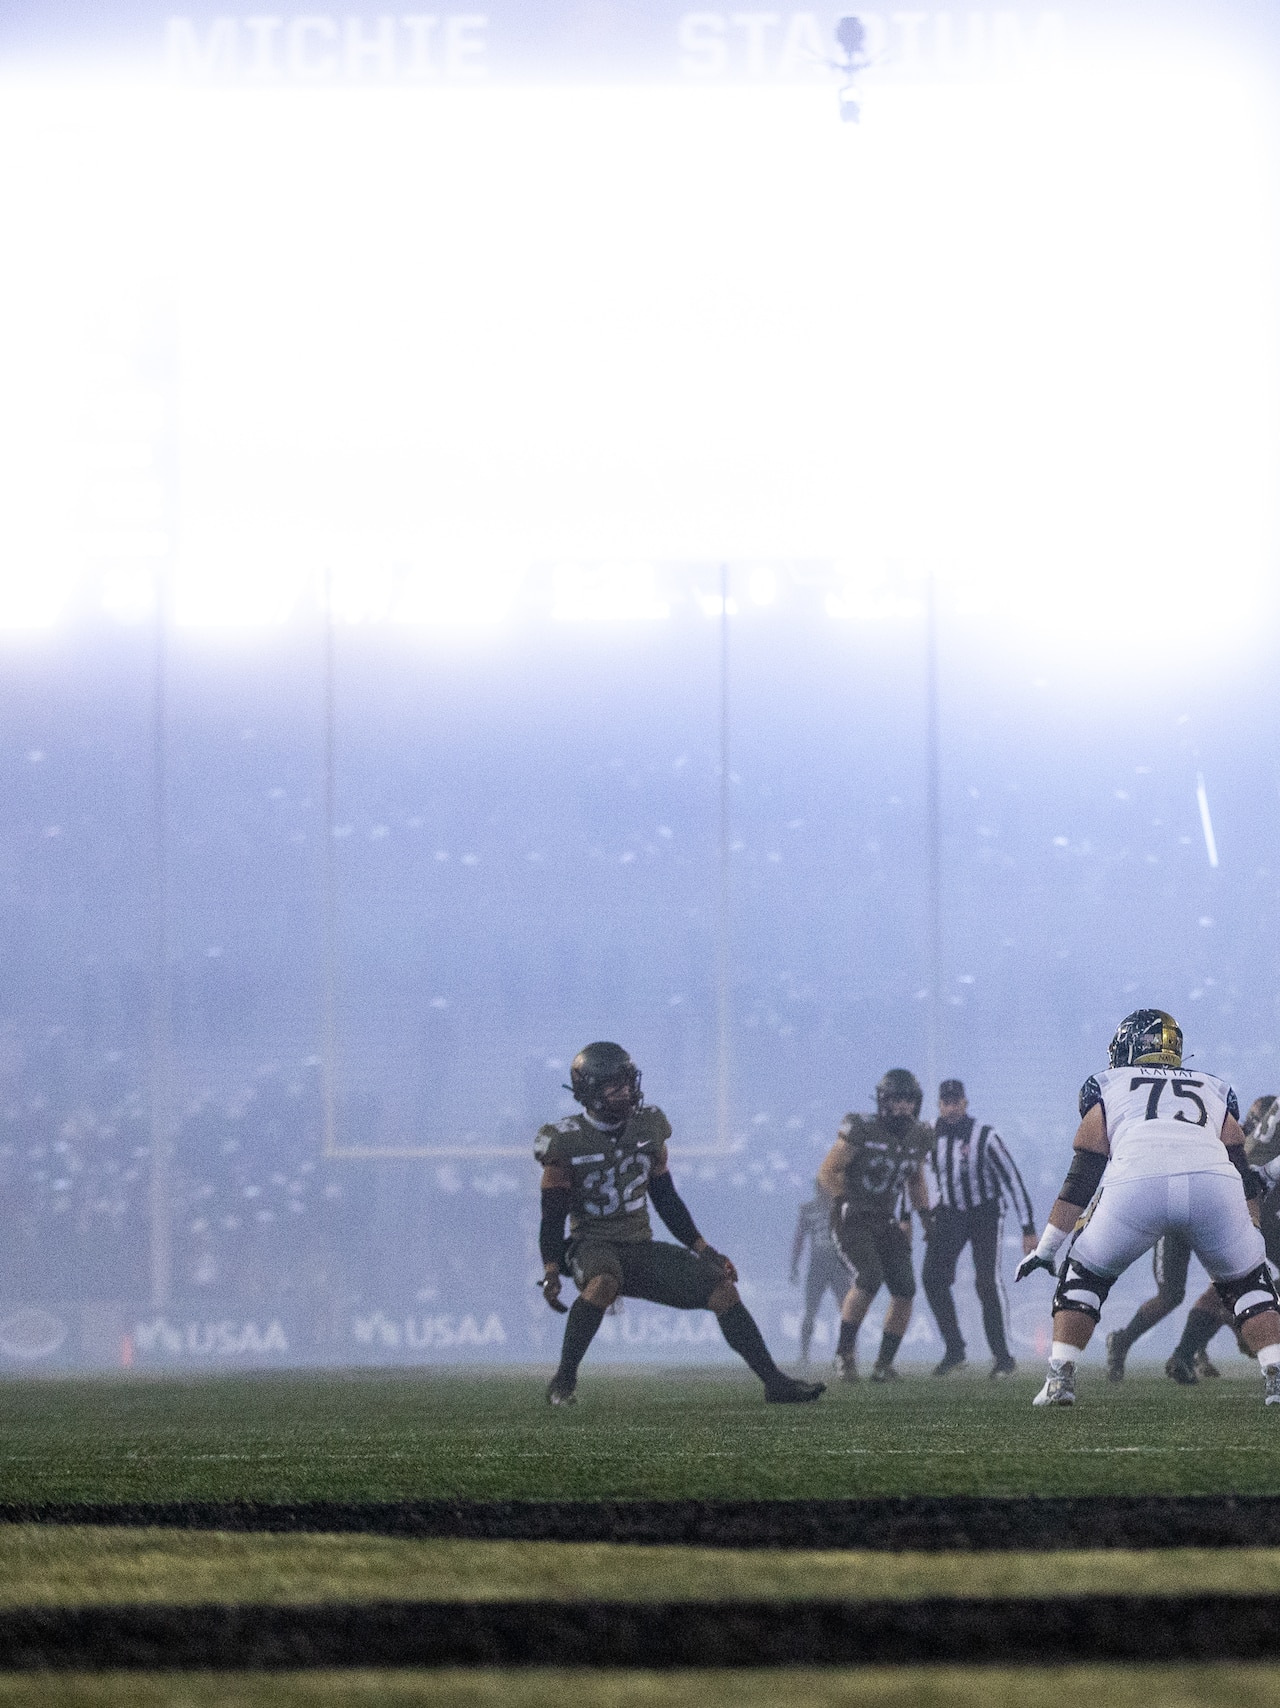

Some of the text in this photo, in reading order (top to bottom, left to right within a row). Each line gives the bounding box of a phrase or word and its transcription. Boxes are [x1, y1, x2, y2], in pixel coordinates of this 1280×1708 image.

[166, 15, 489, 78] MICHIE
[1129, 1077, 1208, 1127] 75
[583, 1152, 652, 1217] 32
[187, 1319, 289, 1355] USAA
[404, 1312, 507, 1347] USAA
